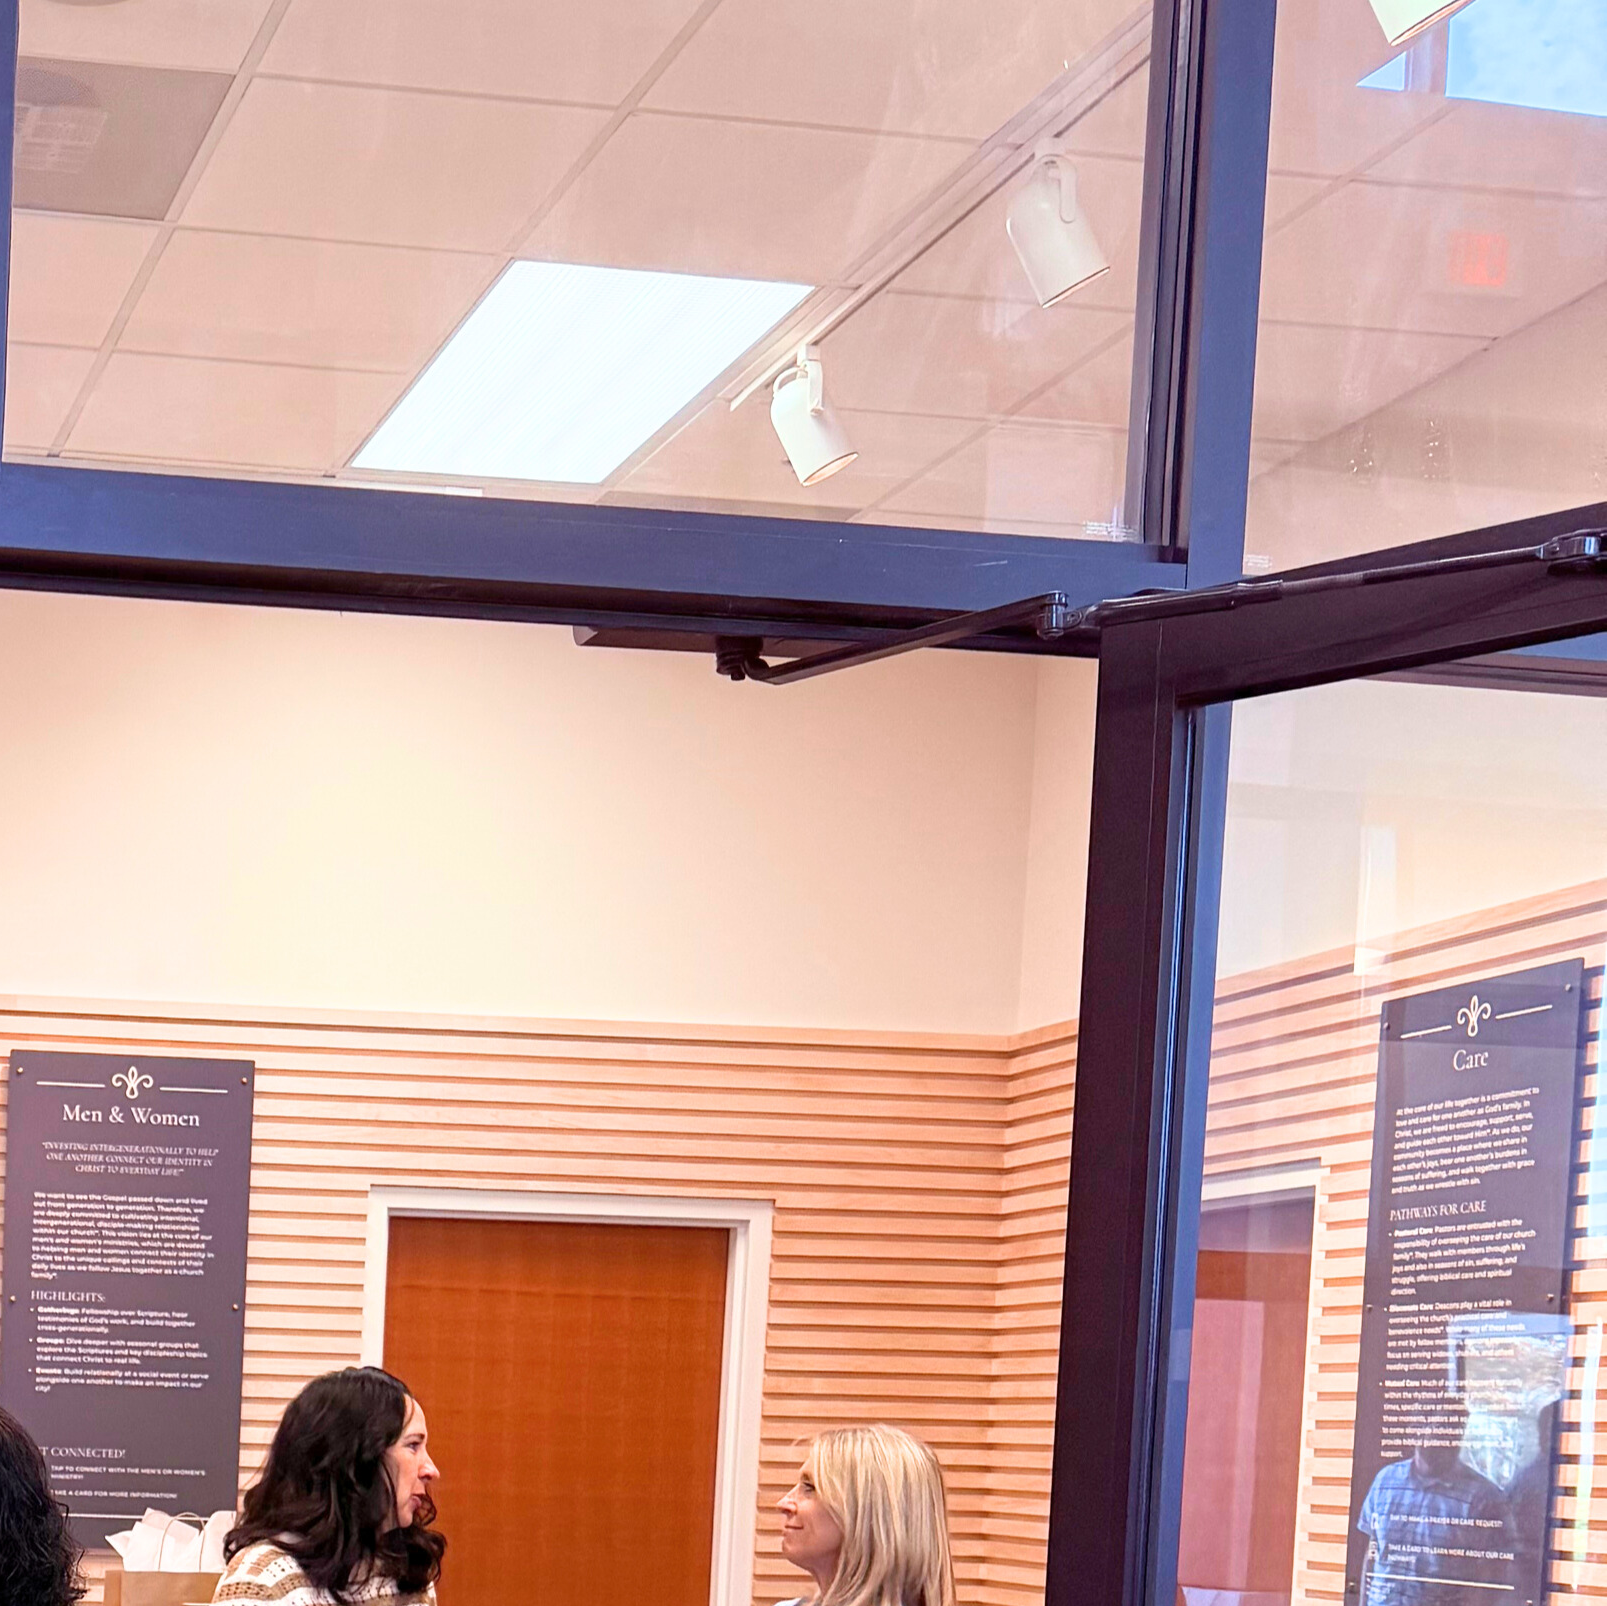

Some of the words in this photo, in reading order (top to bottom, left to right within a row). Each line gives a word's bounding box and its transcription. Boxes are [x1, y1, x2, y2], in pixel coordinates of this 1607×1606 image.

[1453, 1049, 1488, 1071] Care
[62, 1104, 103, 1122] Men
[108, 1106, 124, 1123] &
[130, 1107, 200, 1126] Women
[1389, 1205, 1438, 1220] PATHWAYS
[1439, 1203, 1458, 1216] FOR
[1459, 1200, 1487, 1214] CARE
